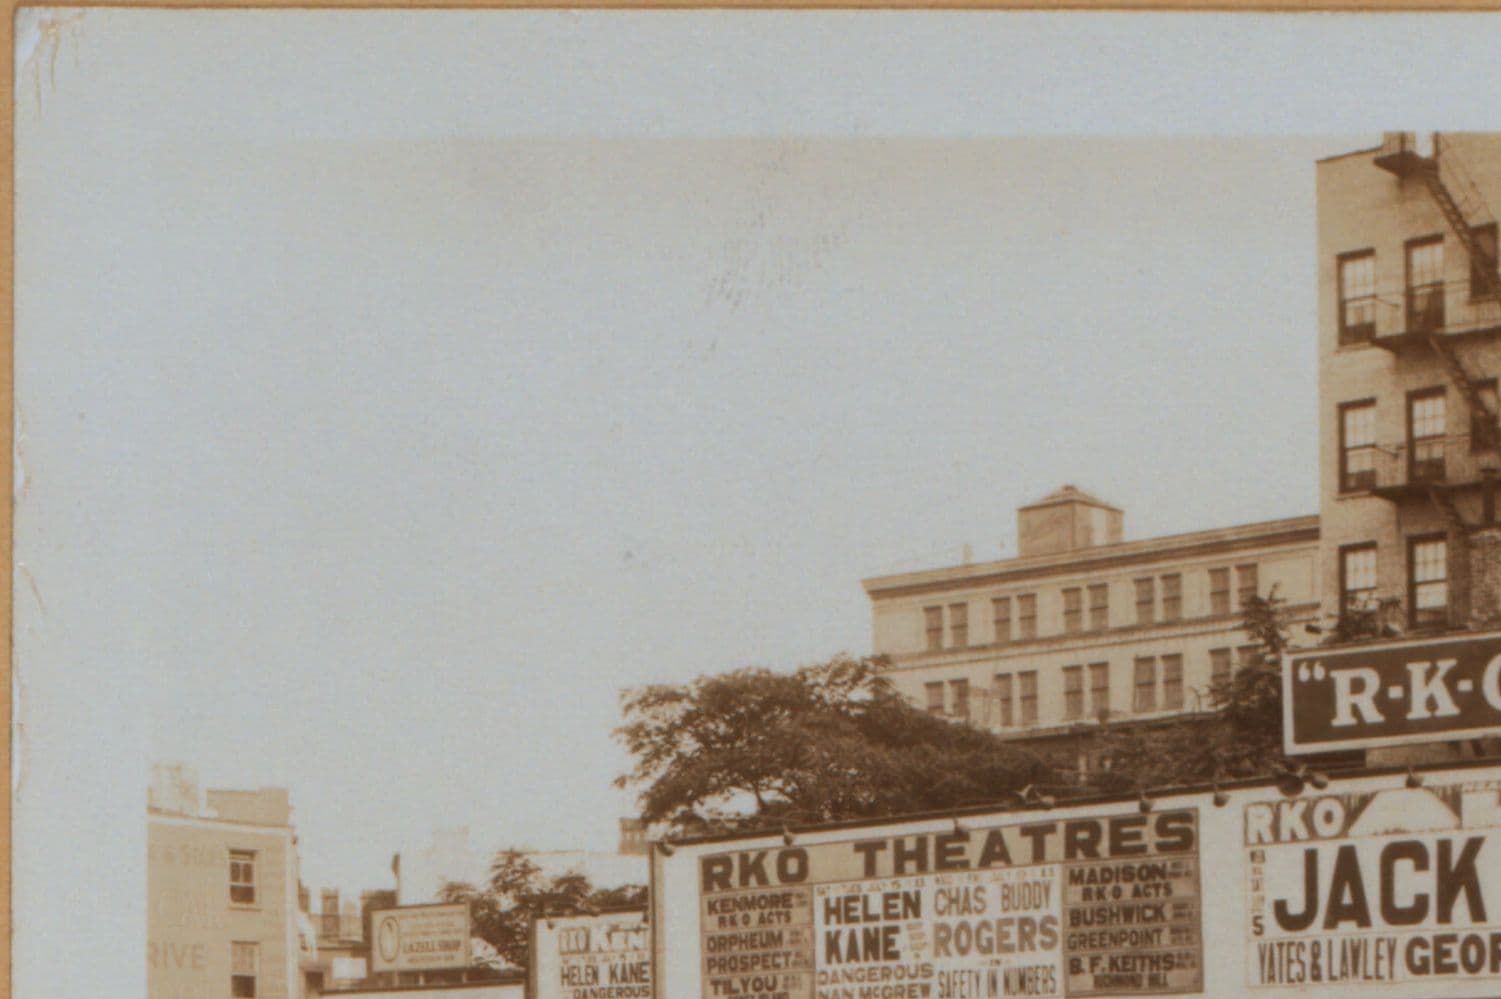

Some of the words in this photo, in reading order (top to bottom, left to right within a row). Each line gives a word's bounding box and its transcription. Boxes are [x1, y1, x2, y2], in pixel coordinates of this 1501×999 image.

[1249, 797, 1347, 843] RKO
[703, 848, 809, 891] RKO
[853, 812, 1194, 878] THEATRES
[1069, 863, 1167, 885] MADISON
[1273, 837, 1487, 932] JACK
[934, 886, 987, 918] CHAS
[1001, 881, 1050, 913] BUDDY
[1132, 882, 1172, 898] ACTS
[707, 892, 793, 916] KENMORE
[824, 889, 921, 926] HELEN
[1068, 904, 1166, 927] BUSHWICK
[758, 910, 792, 925] ACTS
[707, 931, 783, 953] ORPHEUM
[825, 925, 901, 965] KANE
[933, 915, 1059, 959] ROGERS
[1067, 928, 1163, 950] GREENPOINT
[707, 951, 791, 974] PROSPECT
[1257, 941, 1307, 984] YATES
[1310, 940, 1323, 982] &
[1327, 937, 1397, 982] LAWLEY
[561, 965, 599, 986] HELEN
[609, 962, 650, 984] KANE
[711, 976, 777, 996] TILYOU
[817, 963, 934, 986] DANGEROUS
[938, 969, 981, 999] SAFETY
[1003, 965, 1057, 996] NUMBERS
